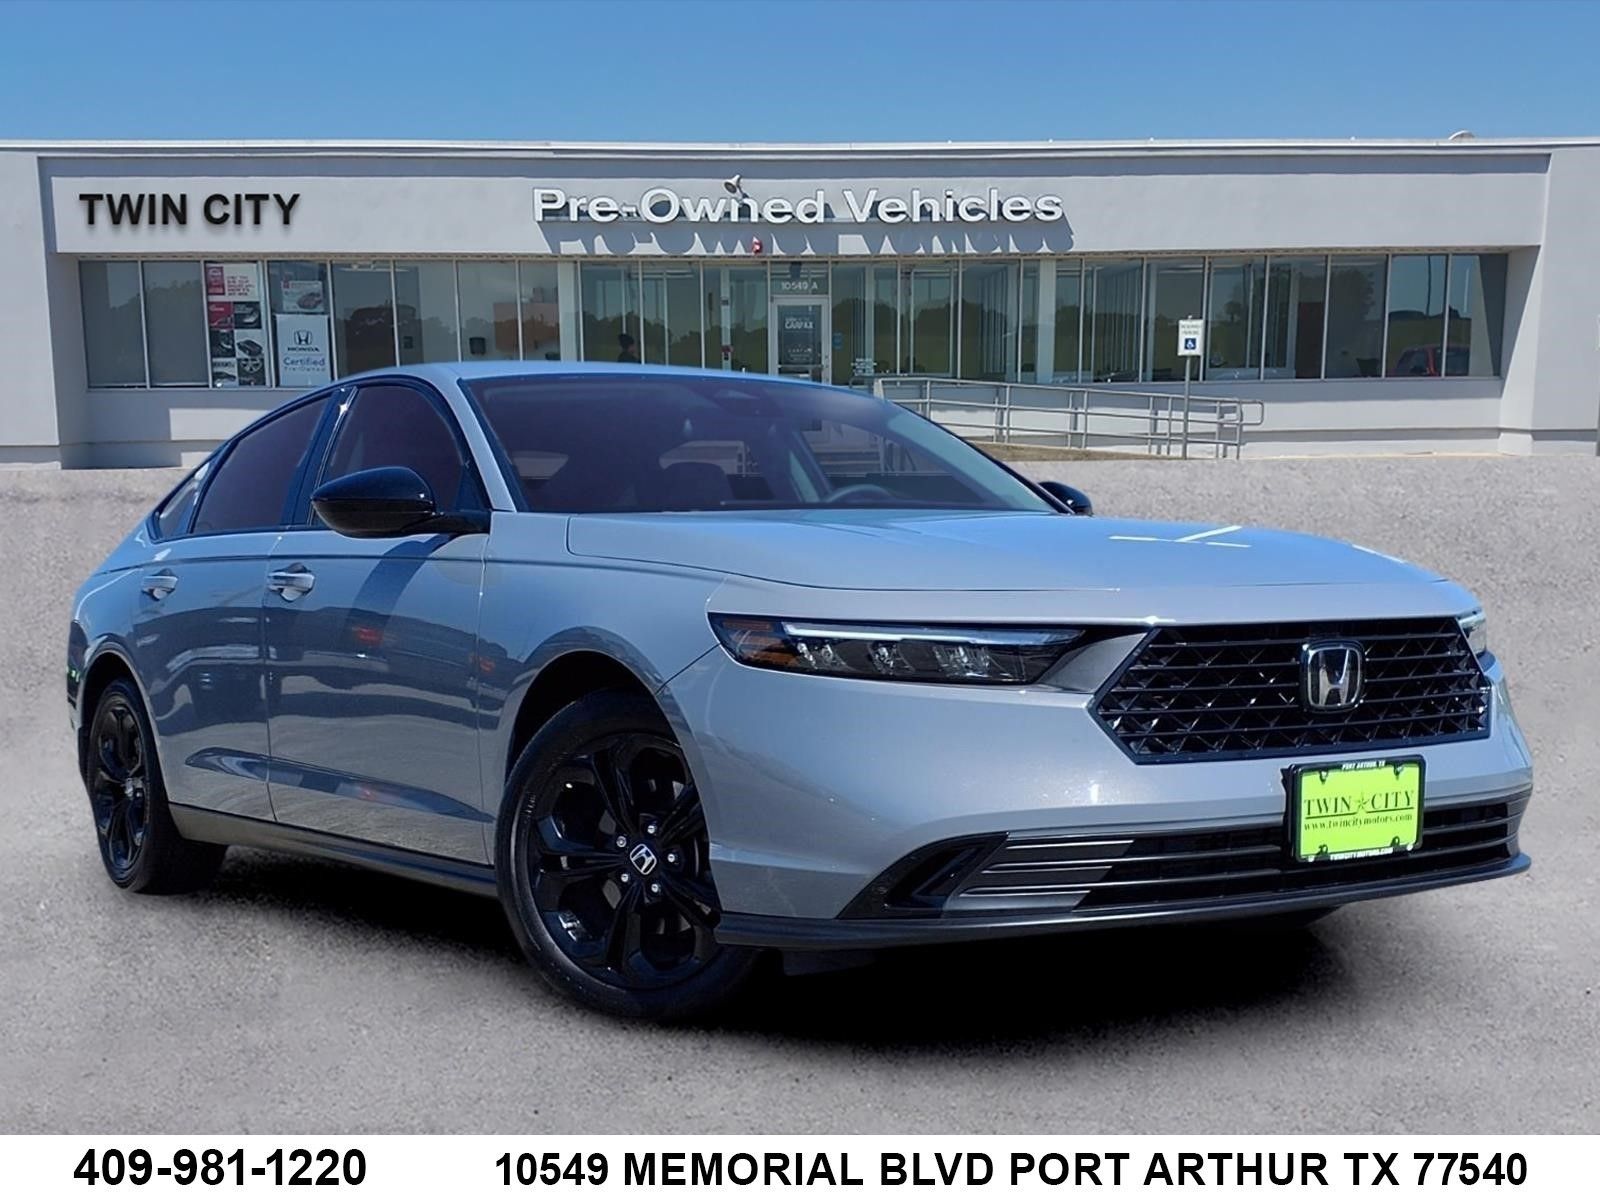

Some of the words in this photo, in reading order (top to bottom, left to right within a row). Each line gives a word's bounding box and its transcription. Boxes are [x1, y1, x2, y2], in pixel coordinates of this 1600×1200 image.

[79, 193, 187, 226] TWIN
[203, 193, 300, 226] CITY
[533, 187, 825, 224] Pre-Owned
[843, 187, 1063, 224] Vehicles
[283, 357, 326, 367] Certified
[1304, 796, 1352, 816] TWIN
[1371, 790, 1414, 810] CITY
[1304, 815, 1413, 831] www.twincitymotors.com
